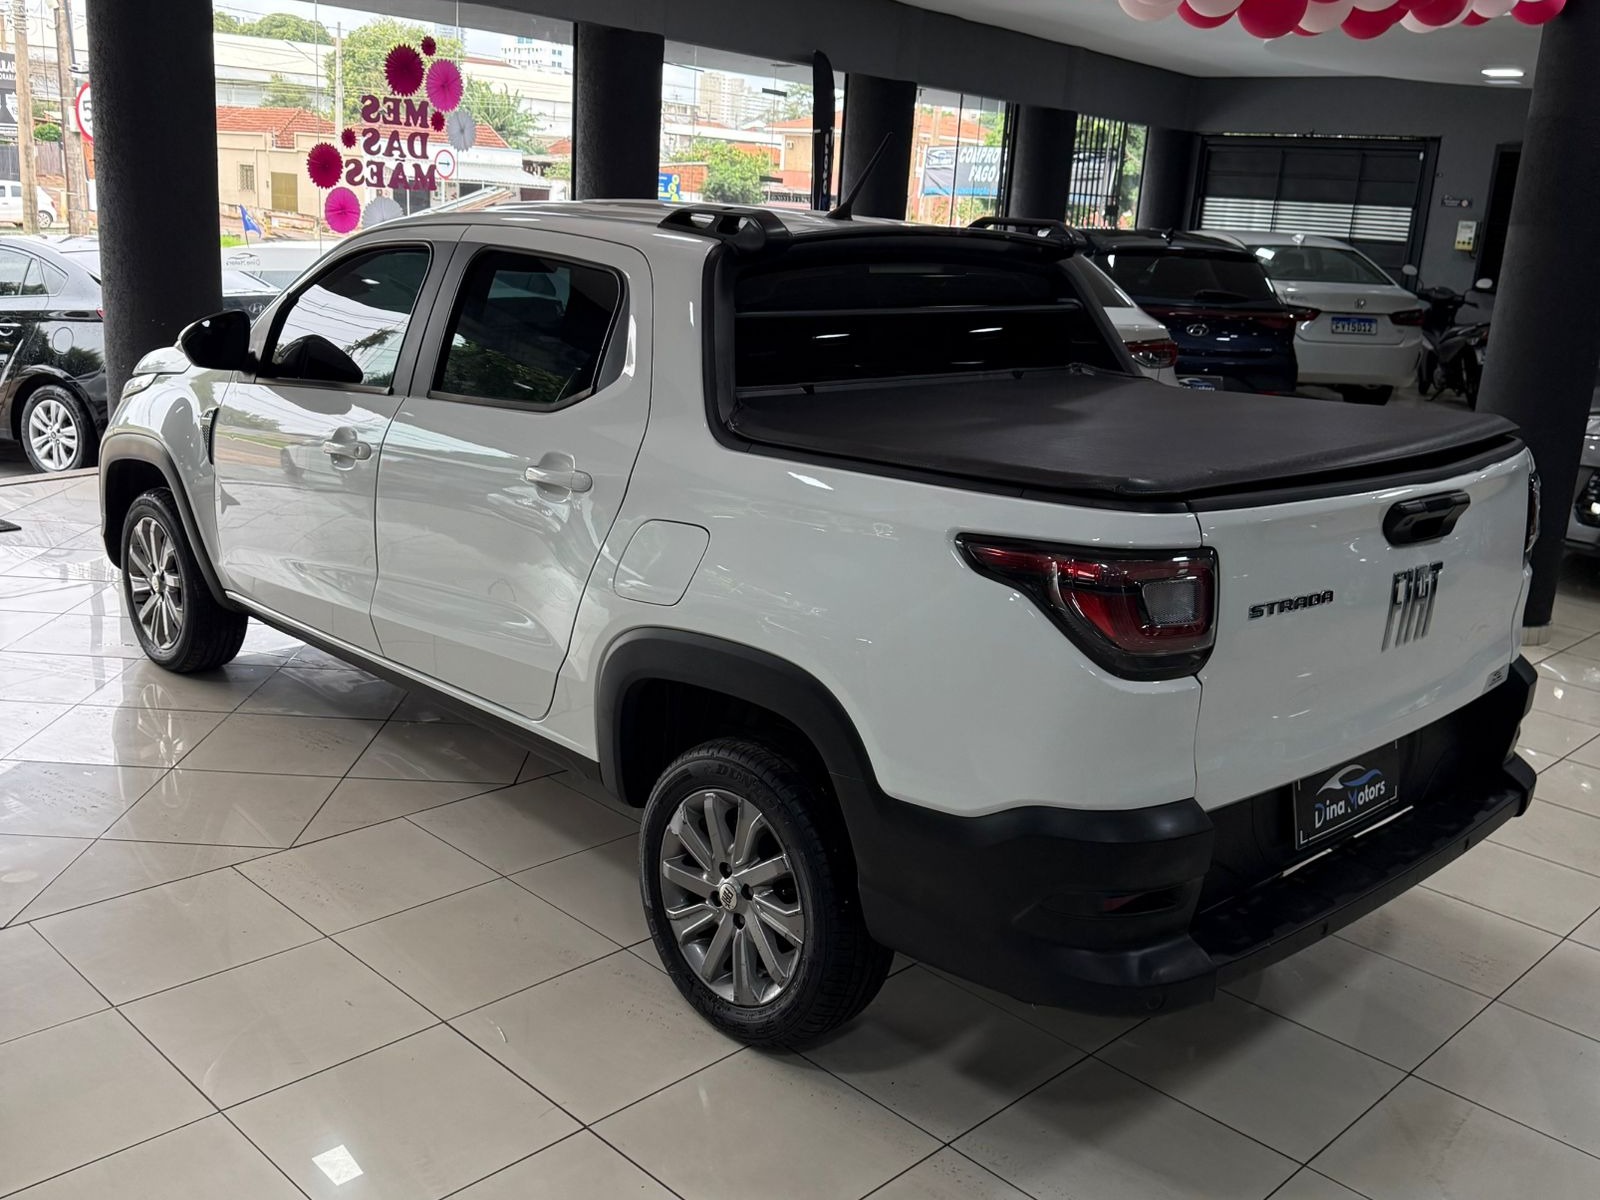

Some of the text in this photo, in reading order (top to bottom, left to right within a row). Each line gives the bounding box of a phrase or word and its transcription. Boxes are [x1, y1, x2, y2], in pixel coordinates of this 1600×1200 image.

[959, 147, 999, 163] COMPRO
[1248, 590, 1334, 620] STRADA
[1382, 561, 1443, 653] FIAT
[1314, 780, 1386, 829] Dina Motors
